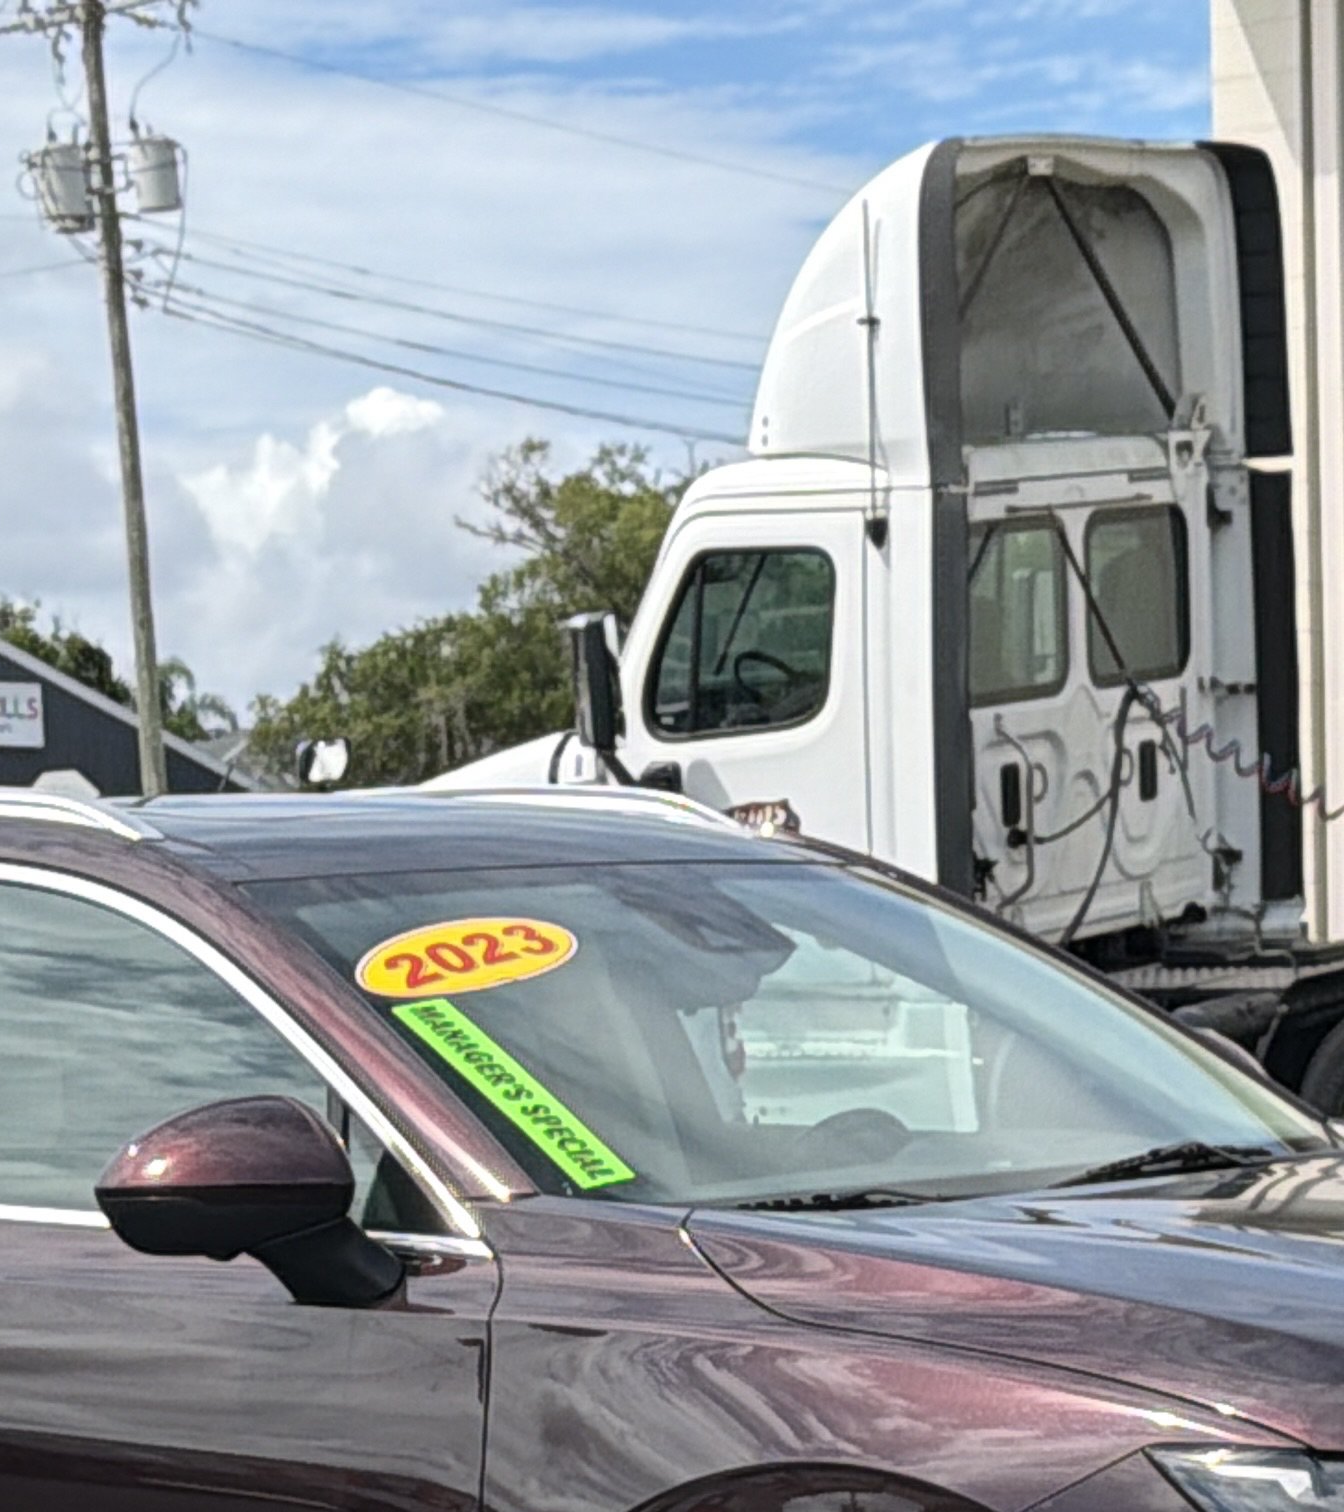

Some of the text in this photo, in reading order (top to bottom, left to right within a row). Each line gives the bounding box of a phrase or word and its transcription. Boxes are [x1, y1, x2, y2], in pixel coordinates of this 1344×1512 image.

[384, 925, 559, 989] 2023
[409, 1005, 616, 1182] MANAGER'S SPECIAL
